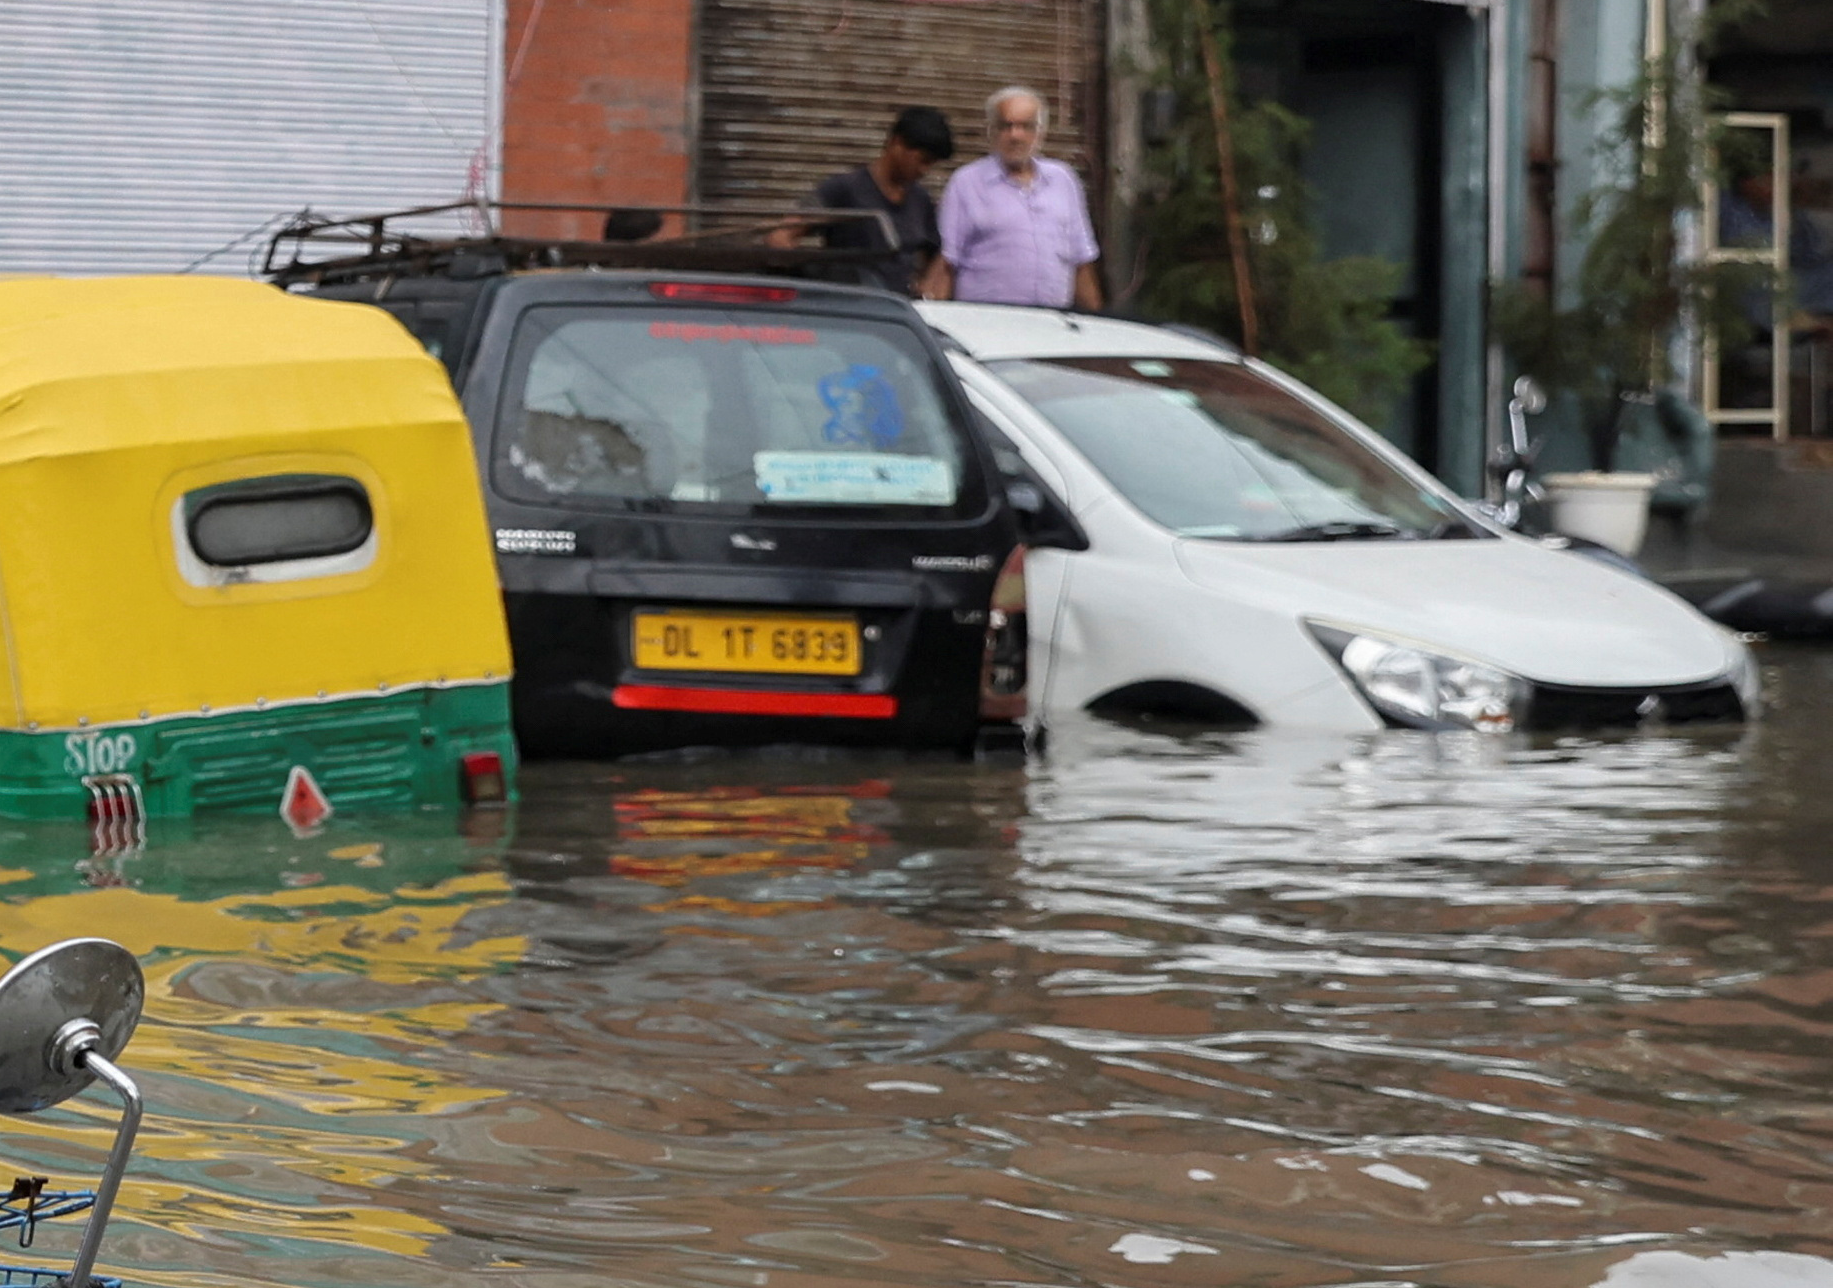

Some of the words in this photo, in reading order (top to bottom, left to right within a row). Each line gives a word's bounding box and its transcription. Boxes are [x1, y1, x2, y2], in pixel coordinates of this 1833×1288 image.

[662, 623, 700, 659] DL
[722, 626, 756, 659] 1T
[63, 732, 136, 775] STOP
